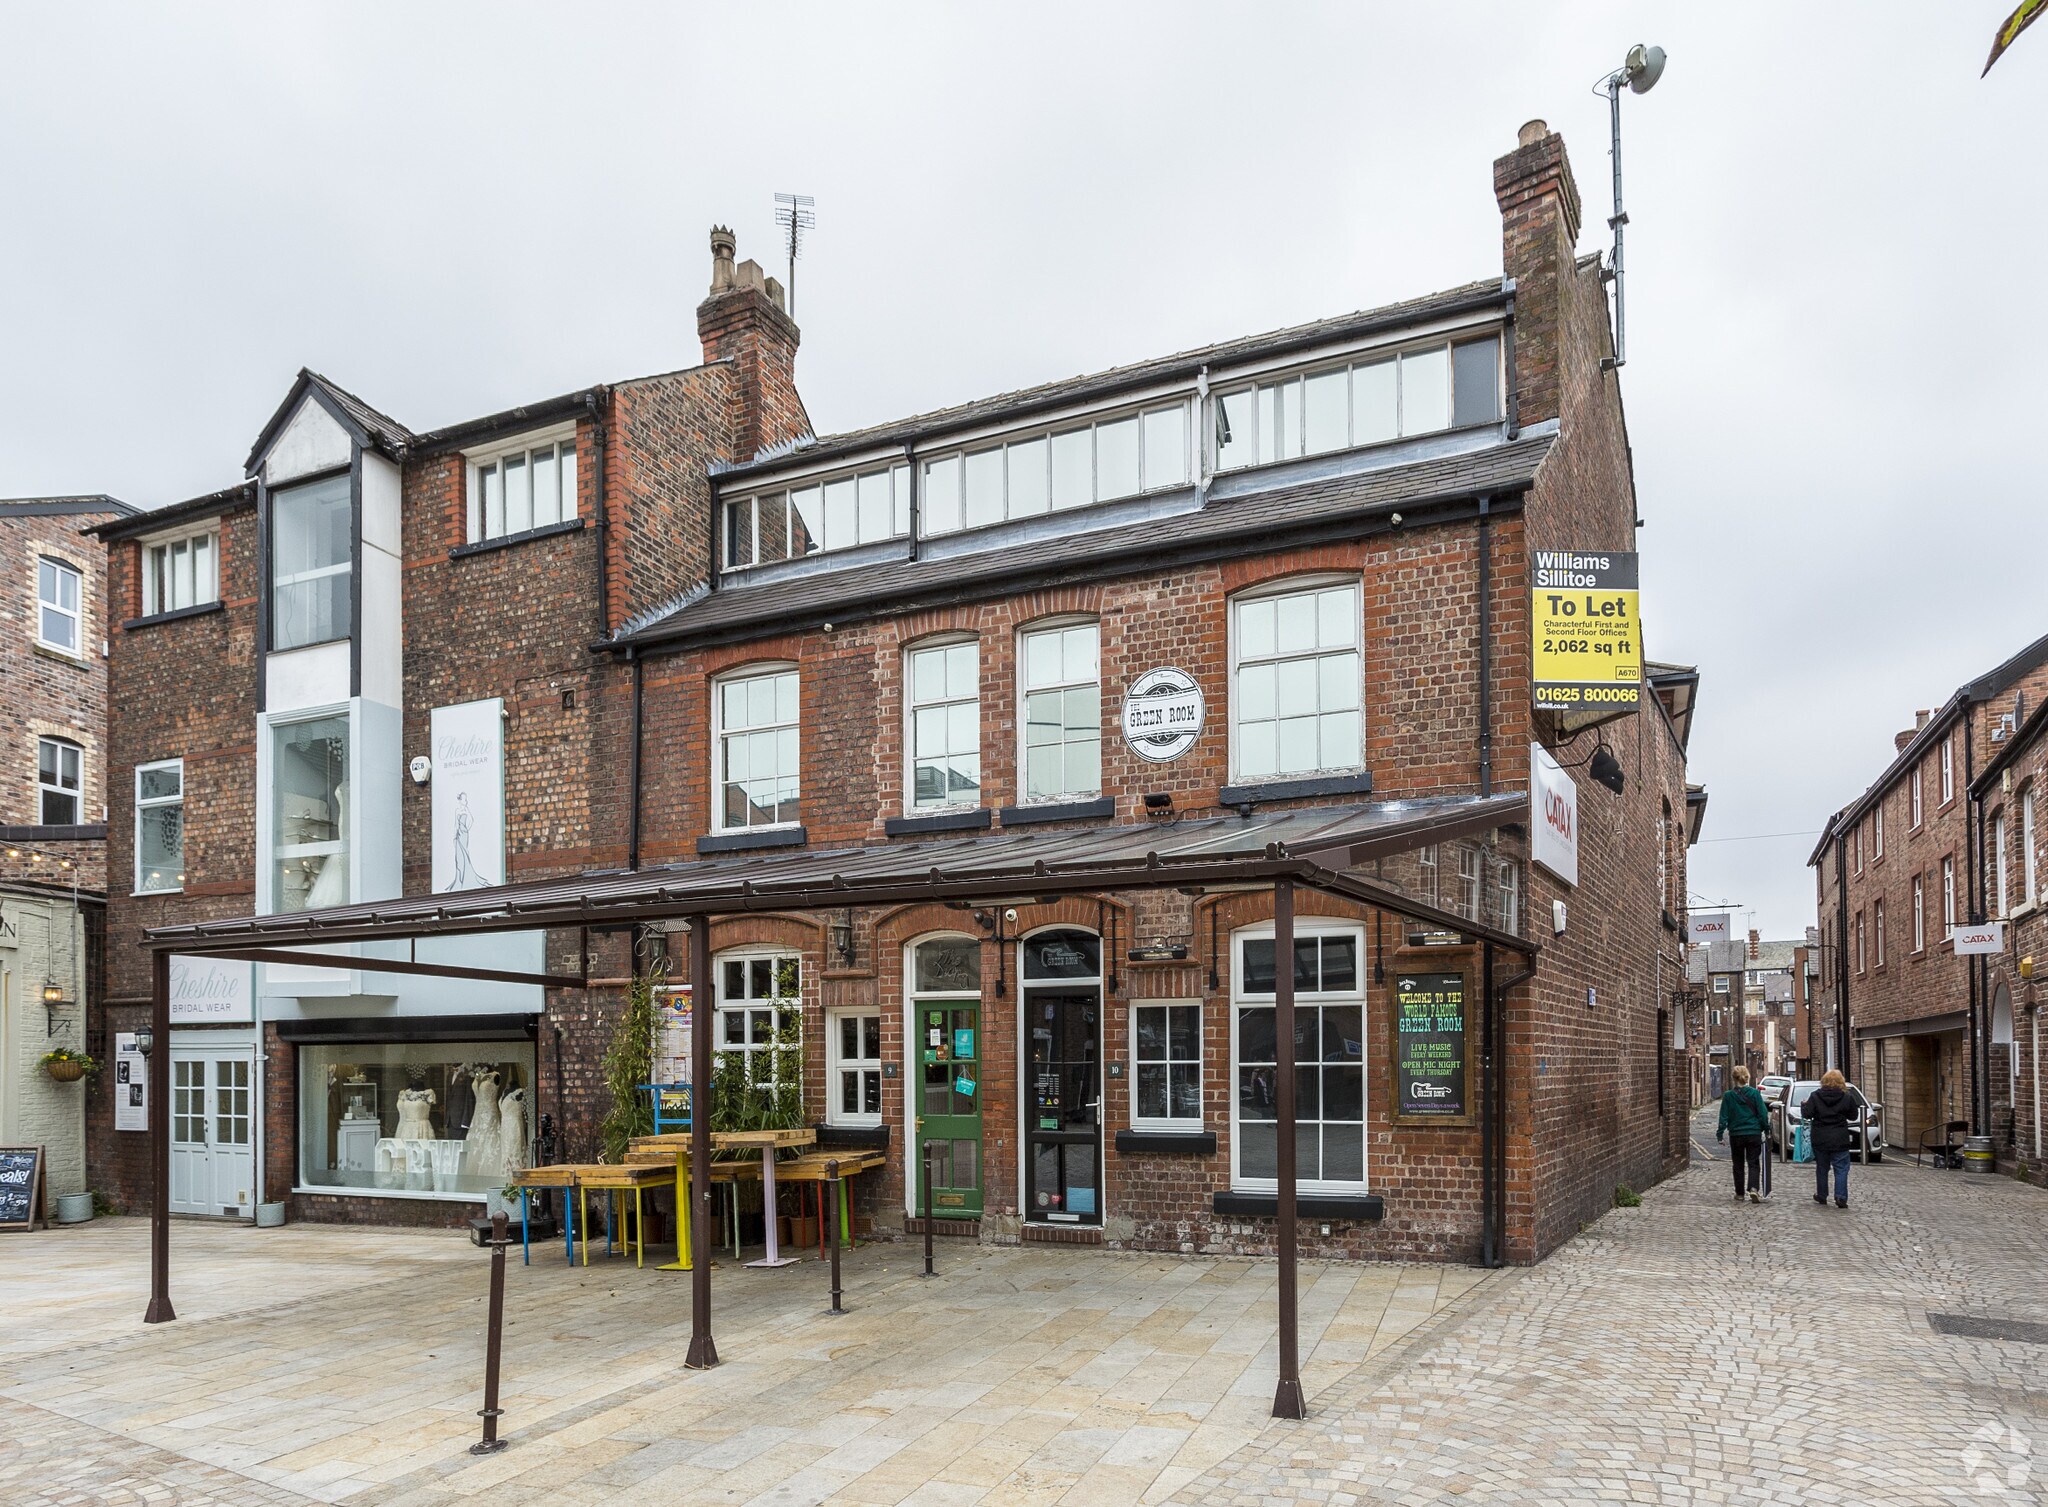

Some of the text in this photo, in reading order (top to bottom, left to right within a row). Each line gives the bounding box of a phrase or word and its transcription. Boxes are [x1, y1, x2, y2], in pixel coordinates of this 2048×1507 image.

[1537, 552, 1610, 570] Williams
[1537, 570, 1596, 587] Sillitoe
[1547, 595, 1626, 617] To Let
[1543, 620, 1630, 629] Characterful First and
[1545, 628, 1628, 637] Second Floor Offices
[1543, 639, 1631, 656] 2,062 sq ft
[1617, 669, 1637, 677] A670
[1536, 688, 1639, 702] 01625 800066
[1130, 704, 1195, 727] GREEN ROOM
[438, 734, 493, 760] Cheshire
[443, 757, 488, 769] BRIDAL WEAR
[1545, 786, 1572, 842] CATAX
[1695, 922, 1725, 932] CATAX
[1962, 934, 1995, 944] CATAX
[169, 963, 239, 1000] Cheshire
[1399, 992, 1462, 1004] WELCOME TO THE
[172, 1003, 232, 1013] BRIDAL WEAR
[1404, 1003, 1458, 1018] WORLD FAMOUS
[1399, 1017, 1463, 1033] GREEN ROOM
[1411, 1043, 1452, 1051] LIVE MUSIC
[887, 1066, 893, 1075] 9
[1111, 1066, 1119, 1074] 10
[1402, 1060, 1461, 1069] OPEN MIC NIGHT
[1427, 1068, 1453, 1076] THURSDAY
[0, 1169, 30, 1185] eals!
